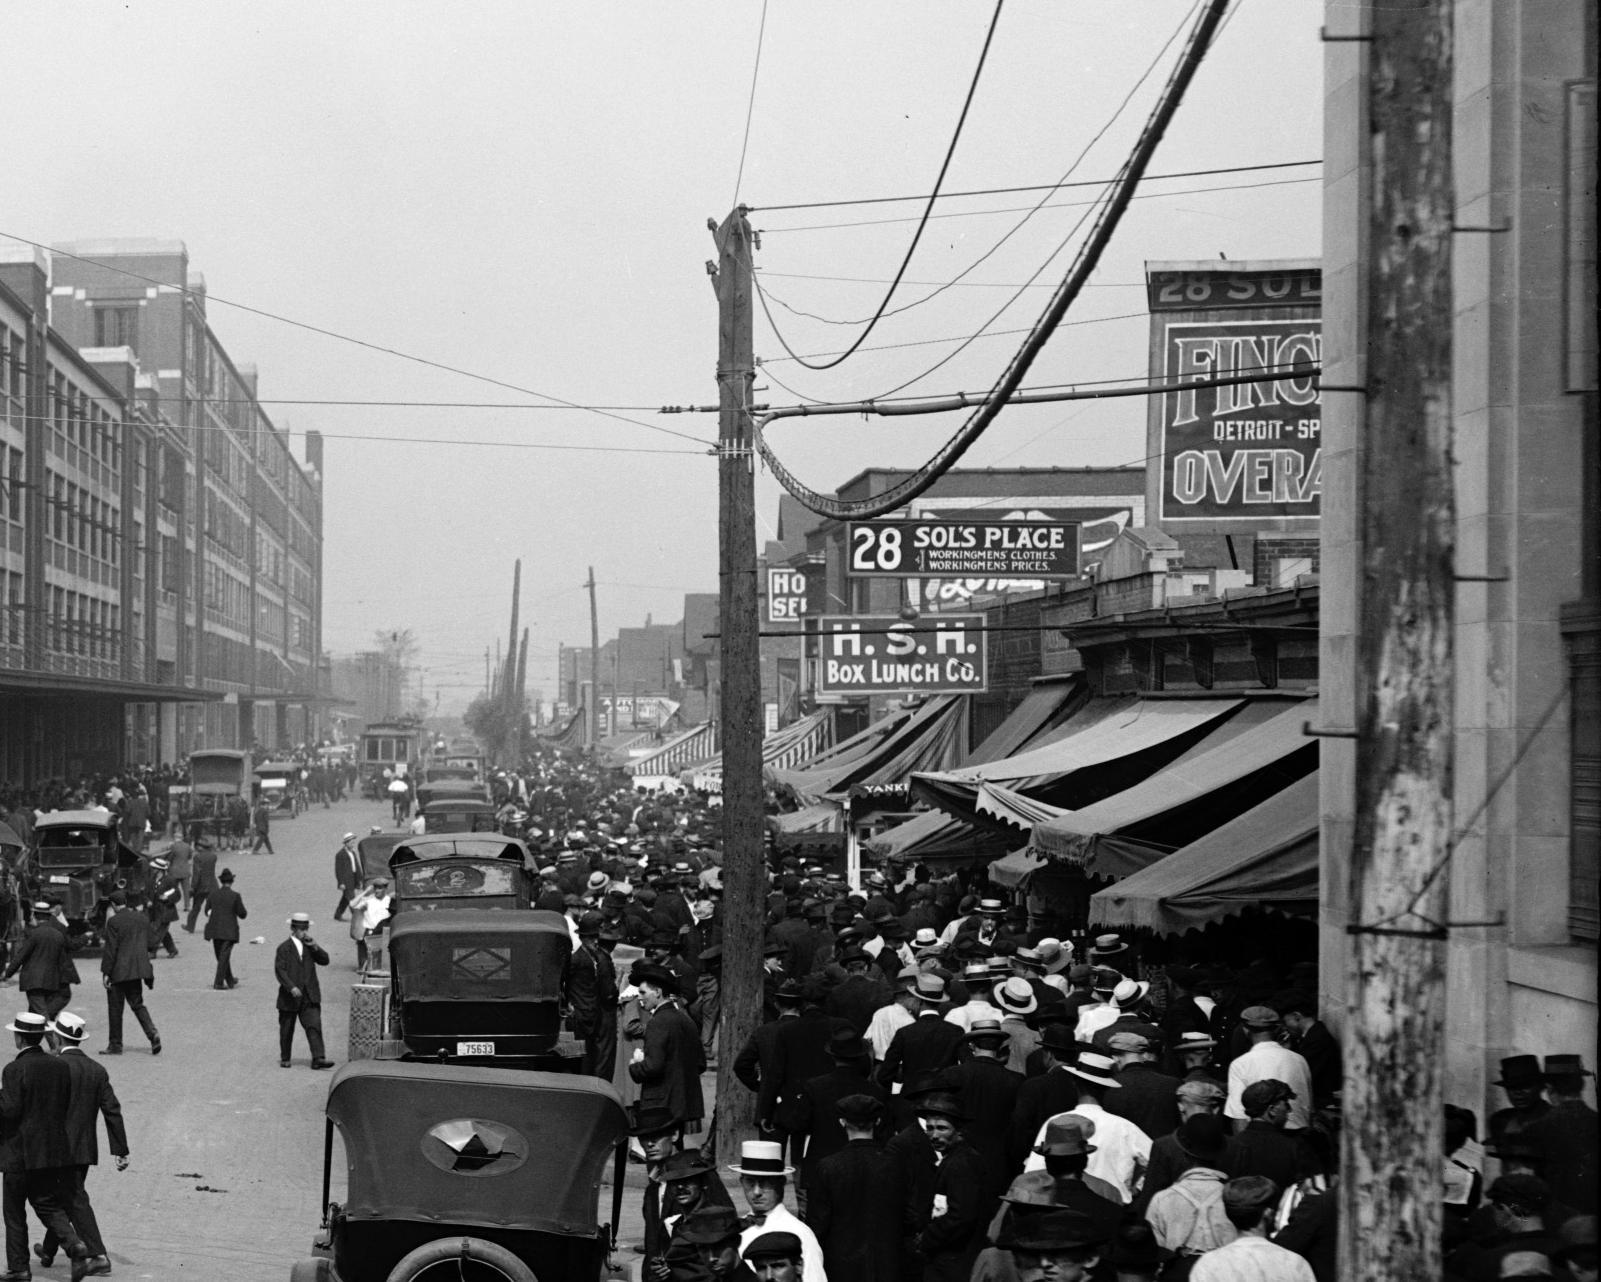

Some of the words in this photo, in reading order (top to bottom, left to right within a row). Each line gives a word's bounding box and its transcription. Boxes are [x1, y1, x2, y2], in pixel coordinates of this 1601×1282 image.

[1159, 273, 1212, 302] 28
[1172, 331, 1321, 427] FINC
[853, 526, 902, 571] 28
[913, 526, 977, 549] SOL'S
[984, 527, 1065, 549] PLACE
[928, 549, 1009, 561] WORKINGMENS'
[1010, 550, 1058, 561] CLOTHES.
[929, 560, 1009, 571] WORKINGMENS'
[1011, 560, 1051, 571] PRICES.
[833, 623, 876, 656] H.
[886, 622, 927, 656] S.
[936, 622, 977, 655] H.
